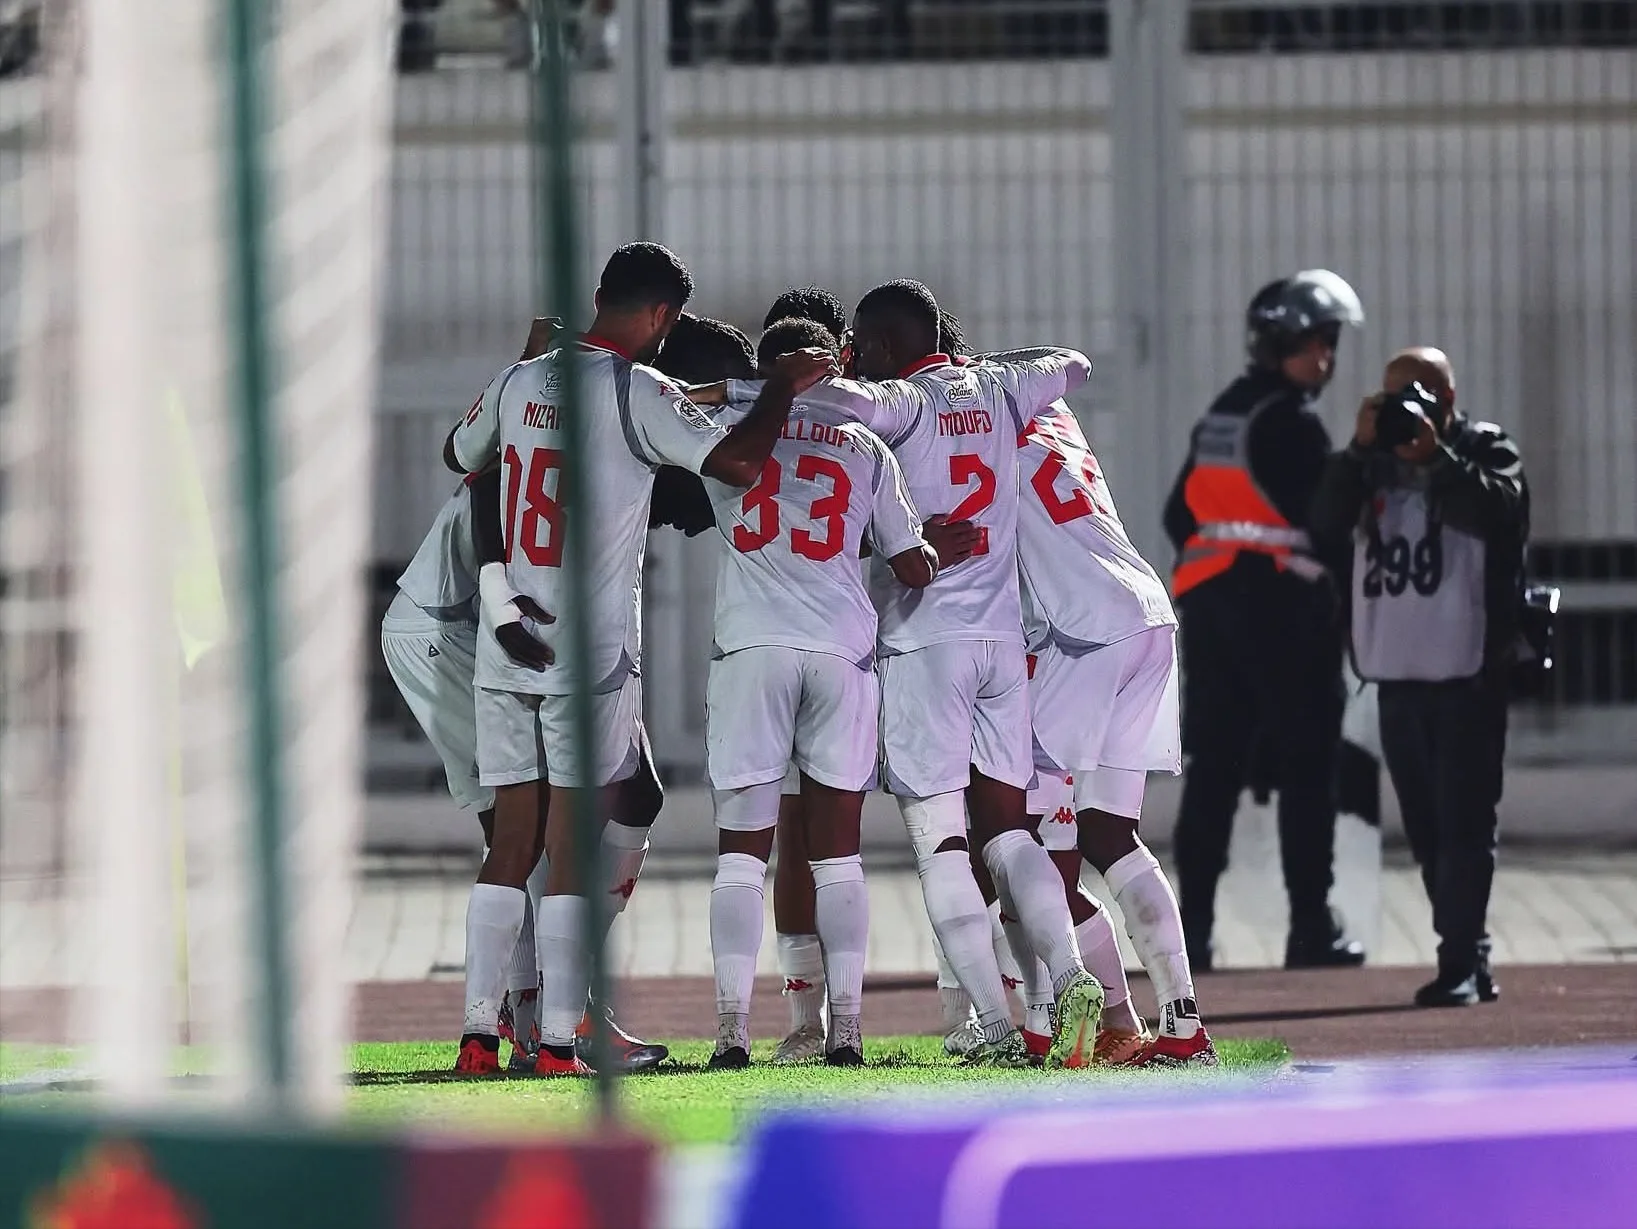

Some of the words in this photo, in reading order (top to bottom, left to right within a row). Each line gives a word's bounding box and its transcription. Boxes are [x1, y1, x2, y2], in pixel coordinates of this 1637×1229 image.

[502, 443, 569, 568] 18
[732, 453, 853, 563] 33
[948, 453, 997, 557] 2
